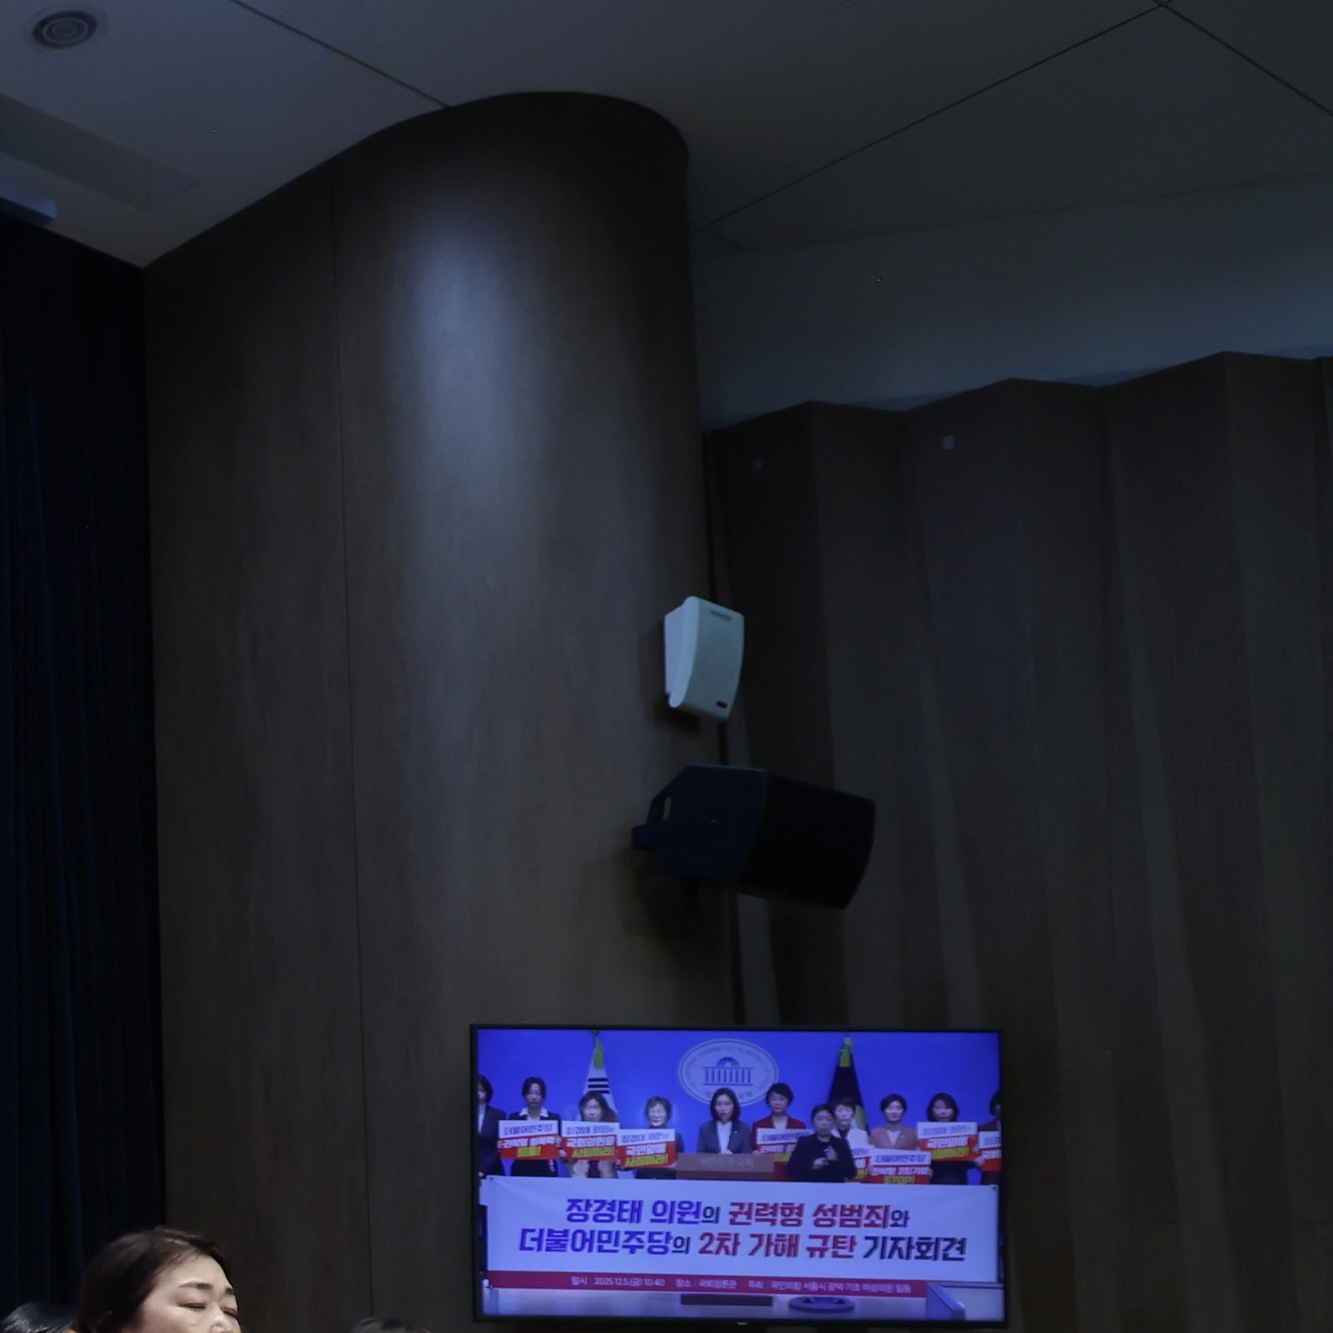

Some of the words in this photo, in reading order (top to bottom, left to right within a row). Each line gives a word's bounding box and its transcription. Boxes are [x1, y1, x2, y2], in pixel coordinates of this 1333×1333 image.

[566, 1198, 644, 1224] 장경태
[650, 1200, 720, 1225] 의원의
[728, 1202, 805, 1228] 권력형
[812, 1203, 910, 1229] 성범죄와
[519, 1228, 691, 1256] 더불어민주당의
[698, 1231, 742, 1257] 2차
[748, 1233, 801, 1258] 가해
[806, 1234, 858, 1260] 규탄
[863, 1235, 968, 1262] 기자회견
